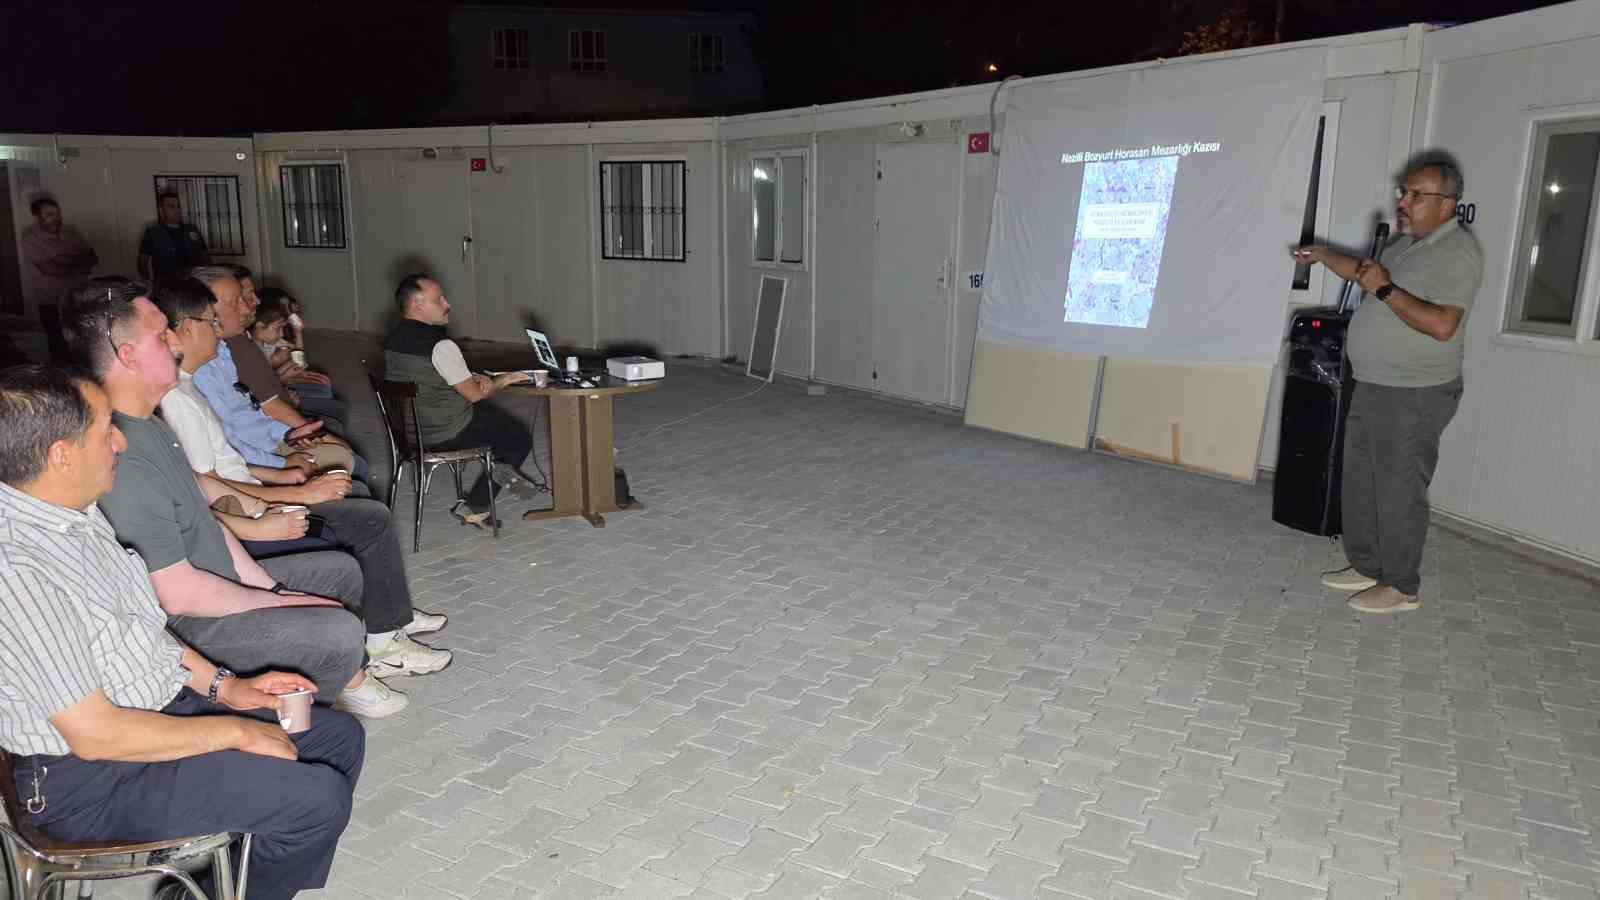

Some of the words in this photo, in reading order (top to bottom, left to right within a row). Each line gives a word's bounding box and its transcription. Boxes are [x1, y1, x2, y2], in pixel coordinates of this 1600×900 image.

[1061, 152, 1084, 163] Nazilli
[1084, 150, 1113, 162] Bozyurt
[1114, 147, 1150, 160] Horasan
[1151, 143, 1192, 157] Mezarlığı
[1193, 141, 1220, 153] Kazısı
